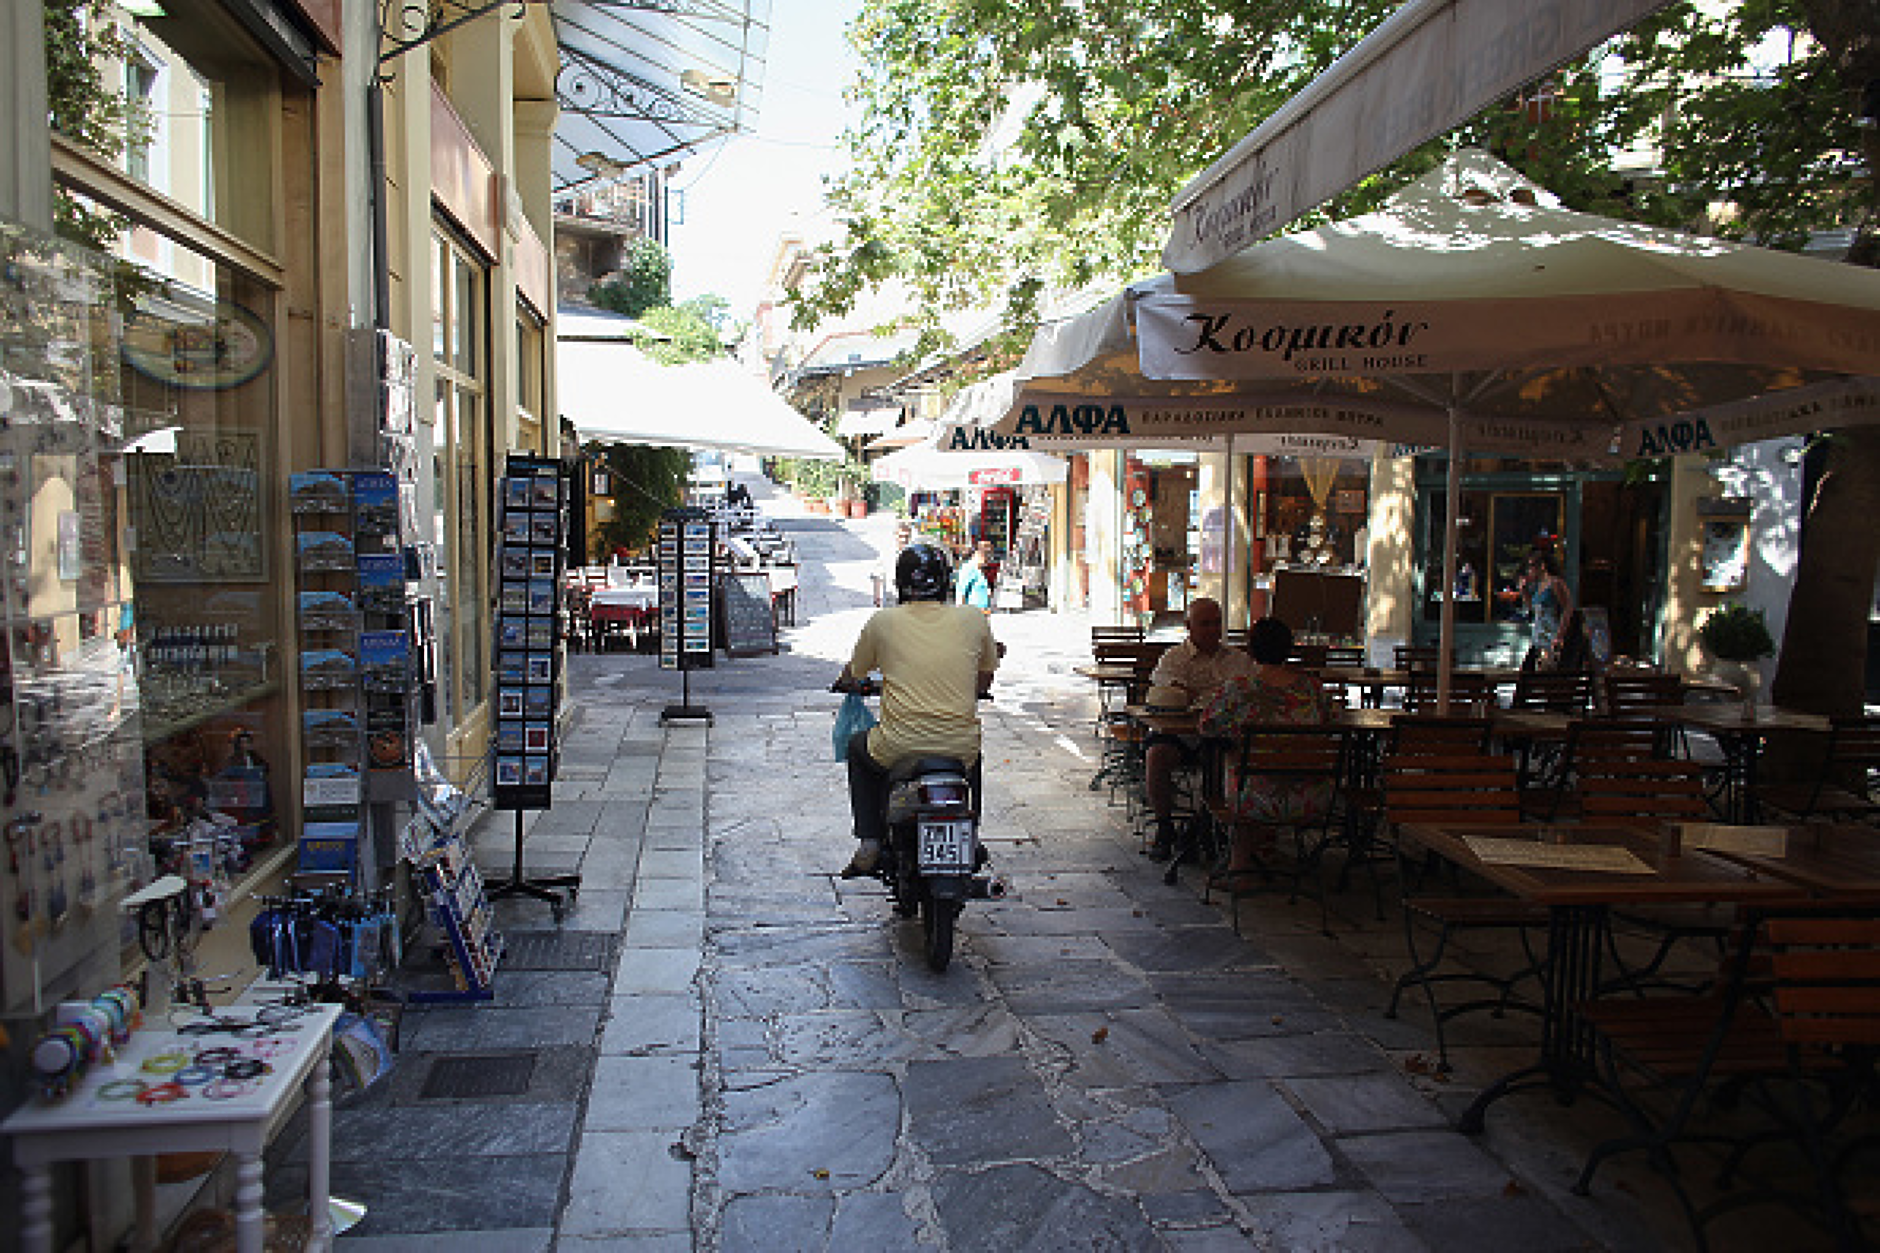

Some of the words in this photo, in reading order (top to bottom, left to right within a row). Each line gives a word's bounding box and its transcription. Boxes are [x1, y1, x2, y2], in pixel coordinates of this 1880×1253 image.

[1294, 356, 1352, 373] GRILL
[1363, 354, 1428, 370] HOUSE
[1015, 405, 1131, 434] ΑΛΦΑ
[1639, 418, 1716, 456] ΑΛΦΑ
